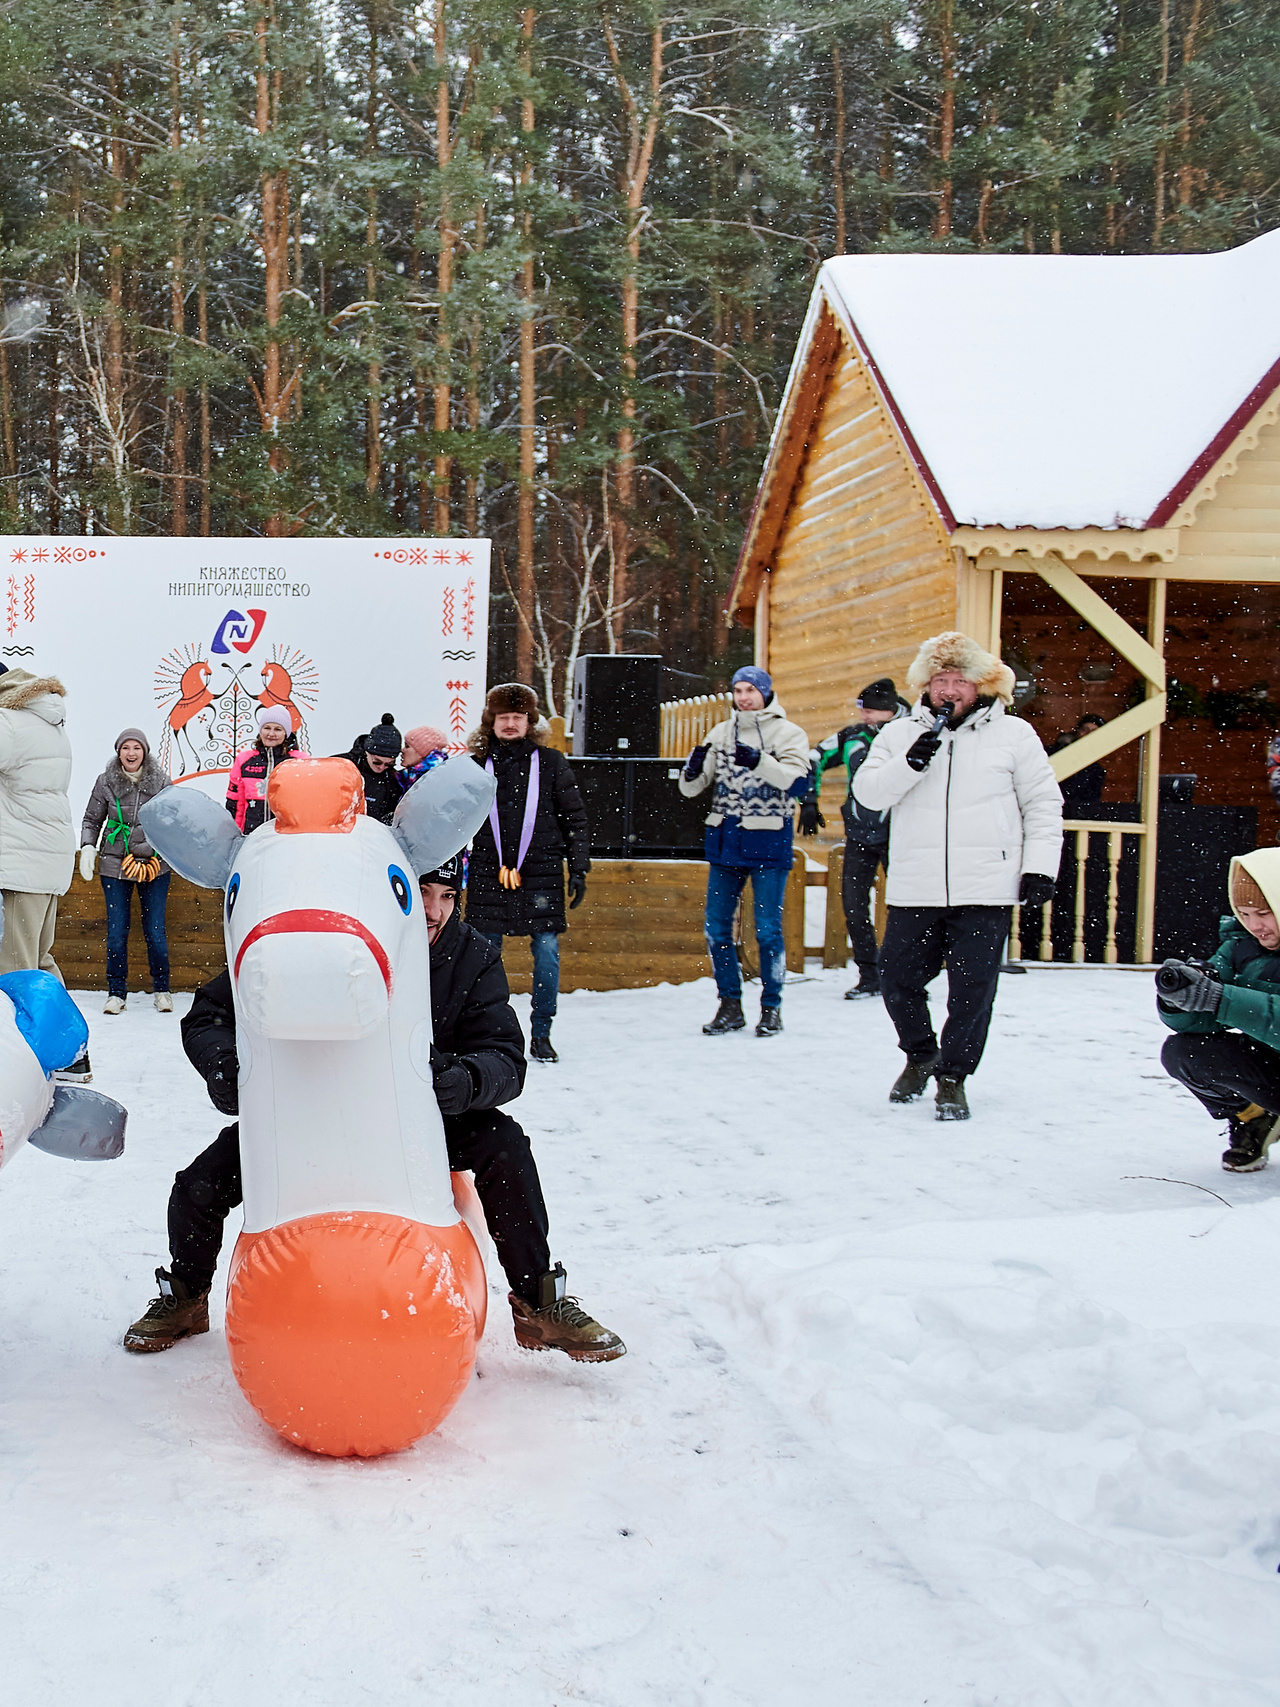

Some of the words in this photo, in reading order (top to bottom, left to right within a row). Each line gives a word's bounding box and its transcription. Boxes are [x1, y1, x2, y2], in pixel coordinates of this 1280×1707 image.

[199, 566, 287, 581] КНЯЖЕСТВО
[168, 582, 311, 599] НИПИГОРМАШЕСТВО
[229, 624, 248, 639] N
